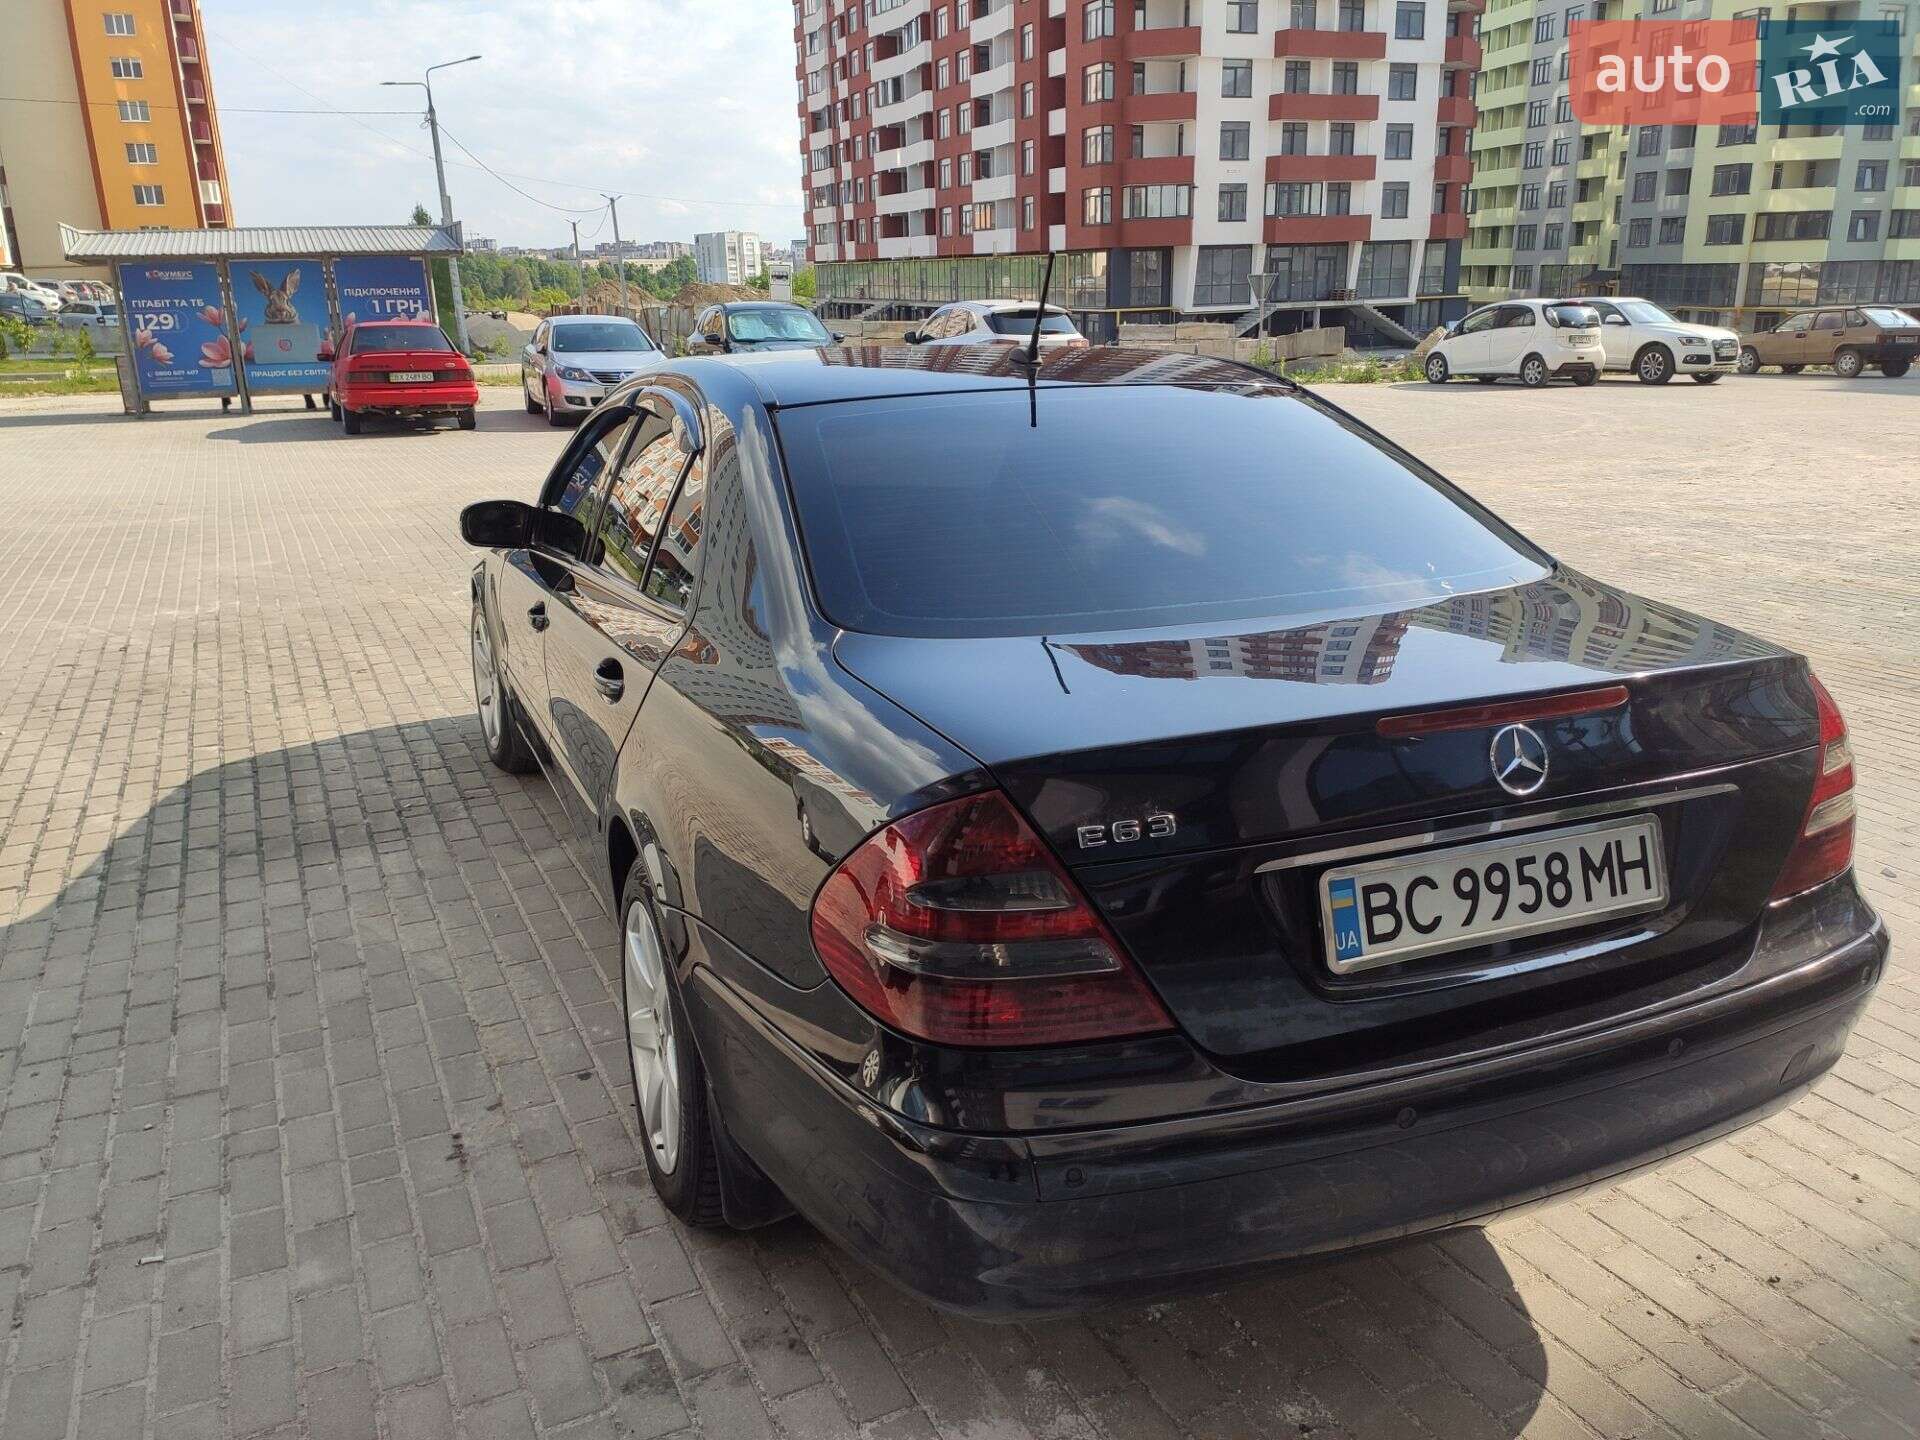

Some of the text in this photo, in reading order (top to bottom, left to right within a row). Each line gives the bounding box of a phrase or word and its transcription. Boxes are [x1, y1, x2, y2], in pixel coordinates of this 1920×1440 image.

[344, 287, 420, 297] ПІДКЛЮЧЕННЯ
[132, 298, 204, 308] ГІГАБІТ ТА ТБ
[372, 299, 423, 313] 1 ГРН
[135, 313, 175, 330] 129
[1077, 814, 1176, 849] E63
[1361, 834, 1652, 945] BC 9958 MH
[1335, 931, 1358, 950] UA
